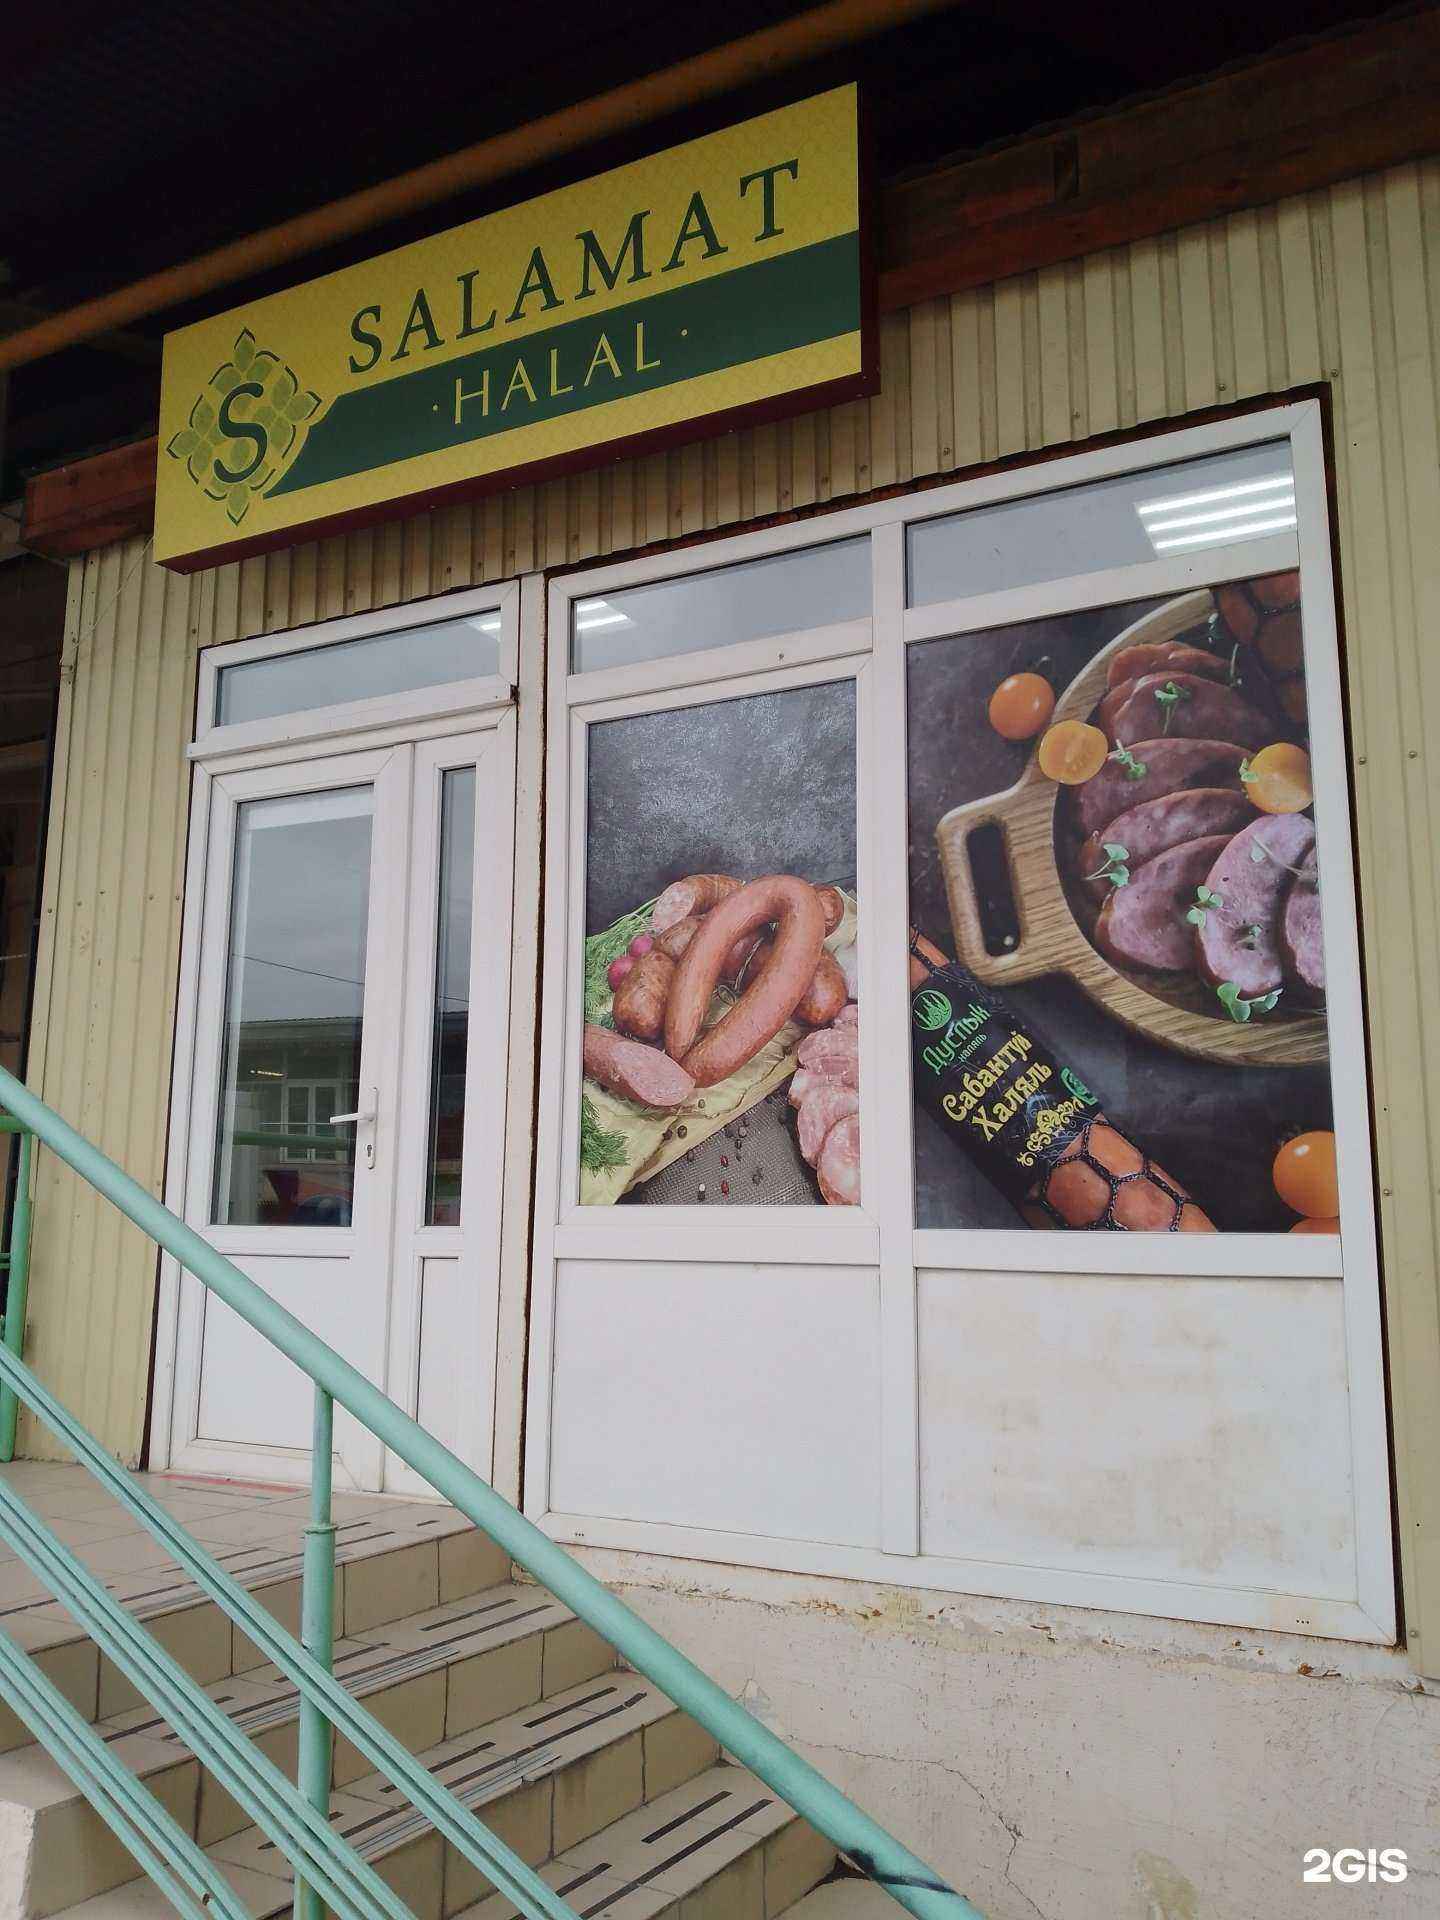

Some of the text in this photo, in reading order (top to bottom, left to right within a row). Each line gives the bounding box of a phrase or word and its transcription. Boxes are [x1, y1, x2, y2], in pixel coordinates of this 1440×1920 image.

[348, 158, 799, 374] SALAMAT
[453, 321, 662, 425] HALAL
[213, 382, 268, 484] S
[942, 1030, 1033, 1122] Сабантуй
[971, 1062, 1053, 1142] Халяль
